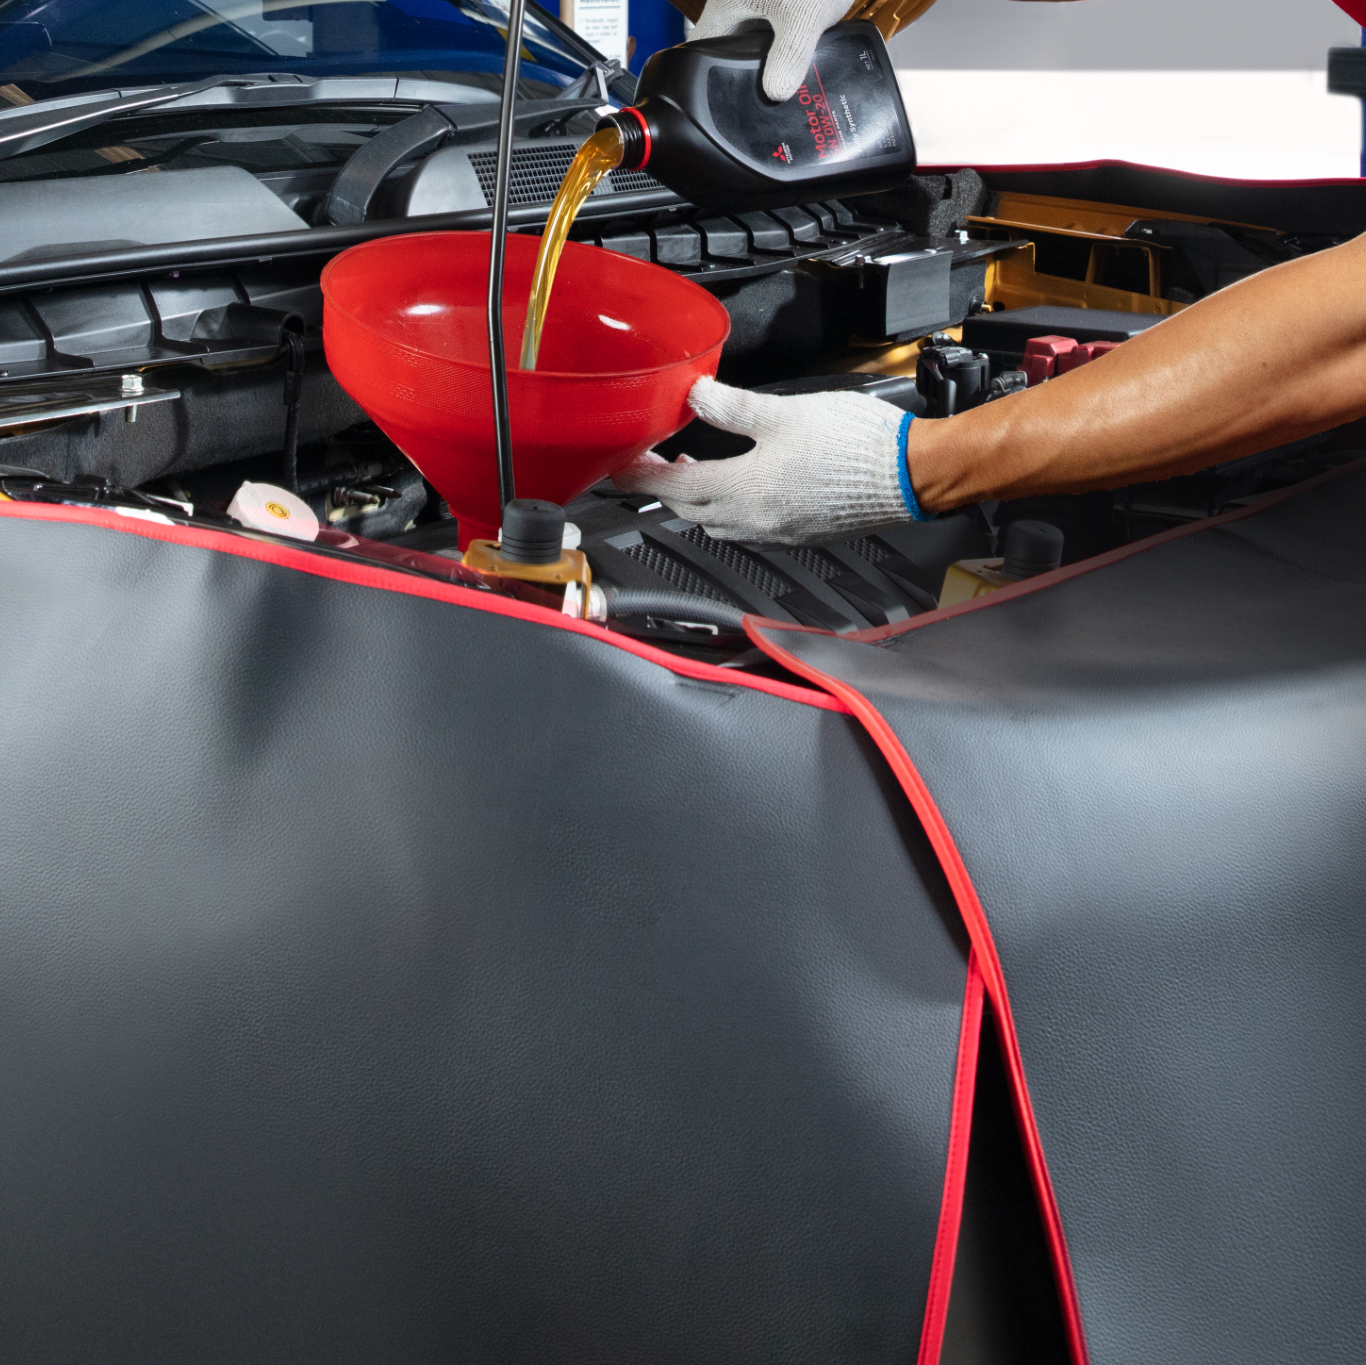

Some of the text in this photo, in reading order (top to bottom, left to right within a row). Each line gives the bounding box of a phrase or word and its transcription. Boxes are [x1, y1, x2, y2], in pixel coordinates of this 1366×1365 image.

[806, 109, 829, 159] Motor
[813, 94, 834, 136] 0W-20
[840, 94, 856, 133] Synthetic
